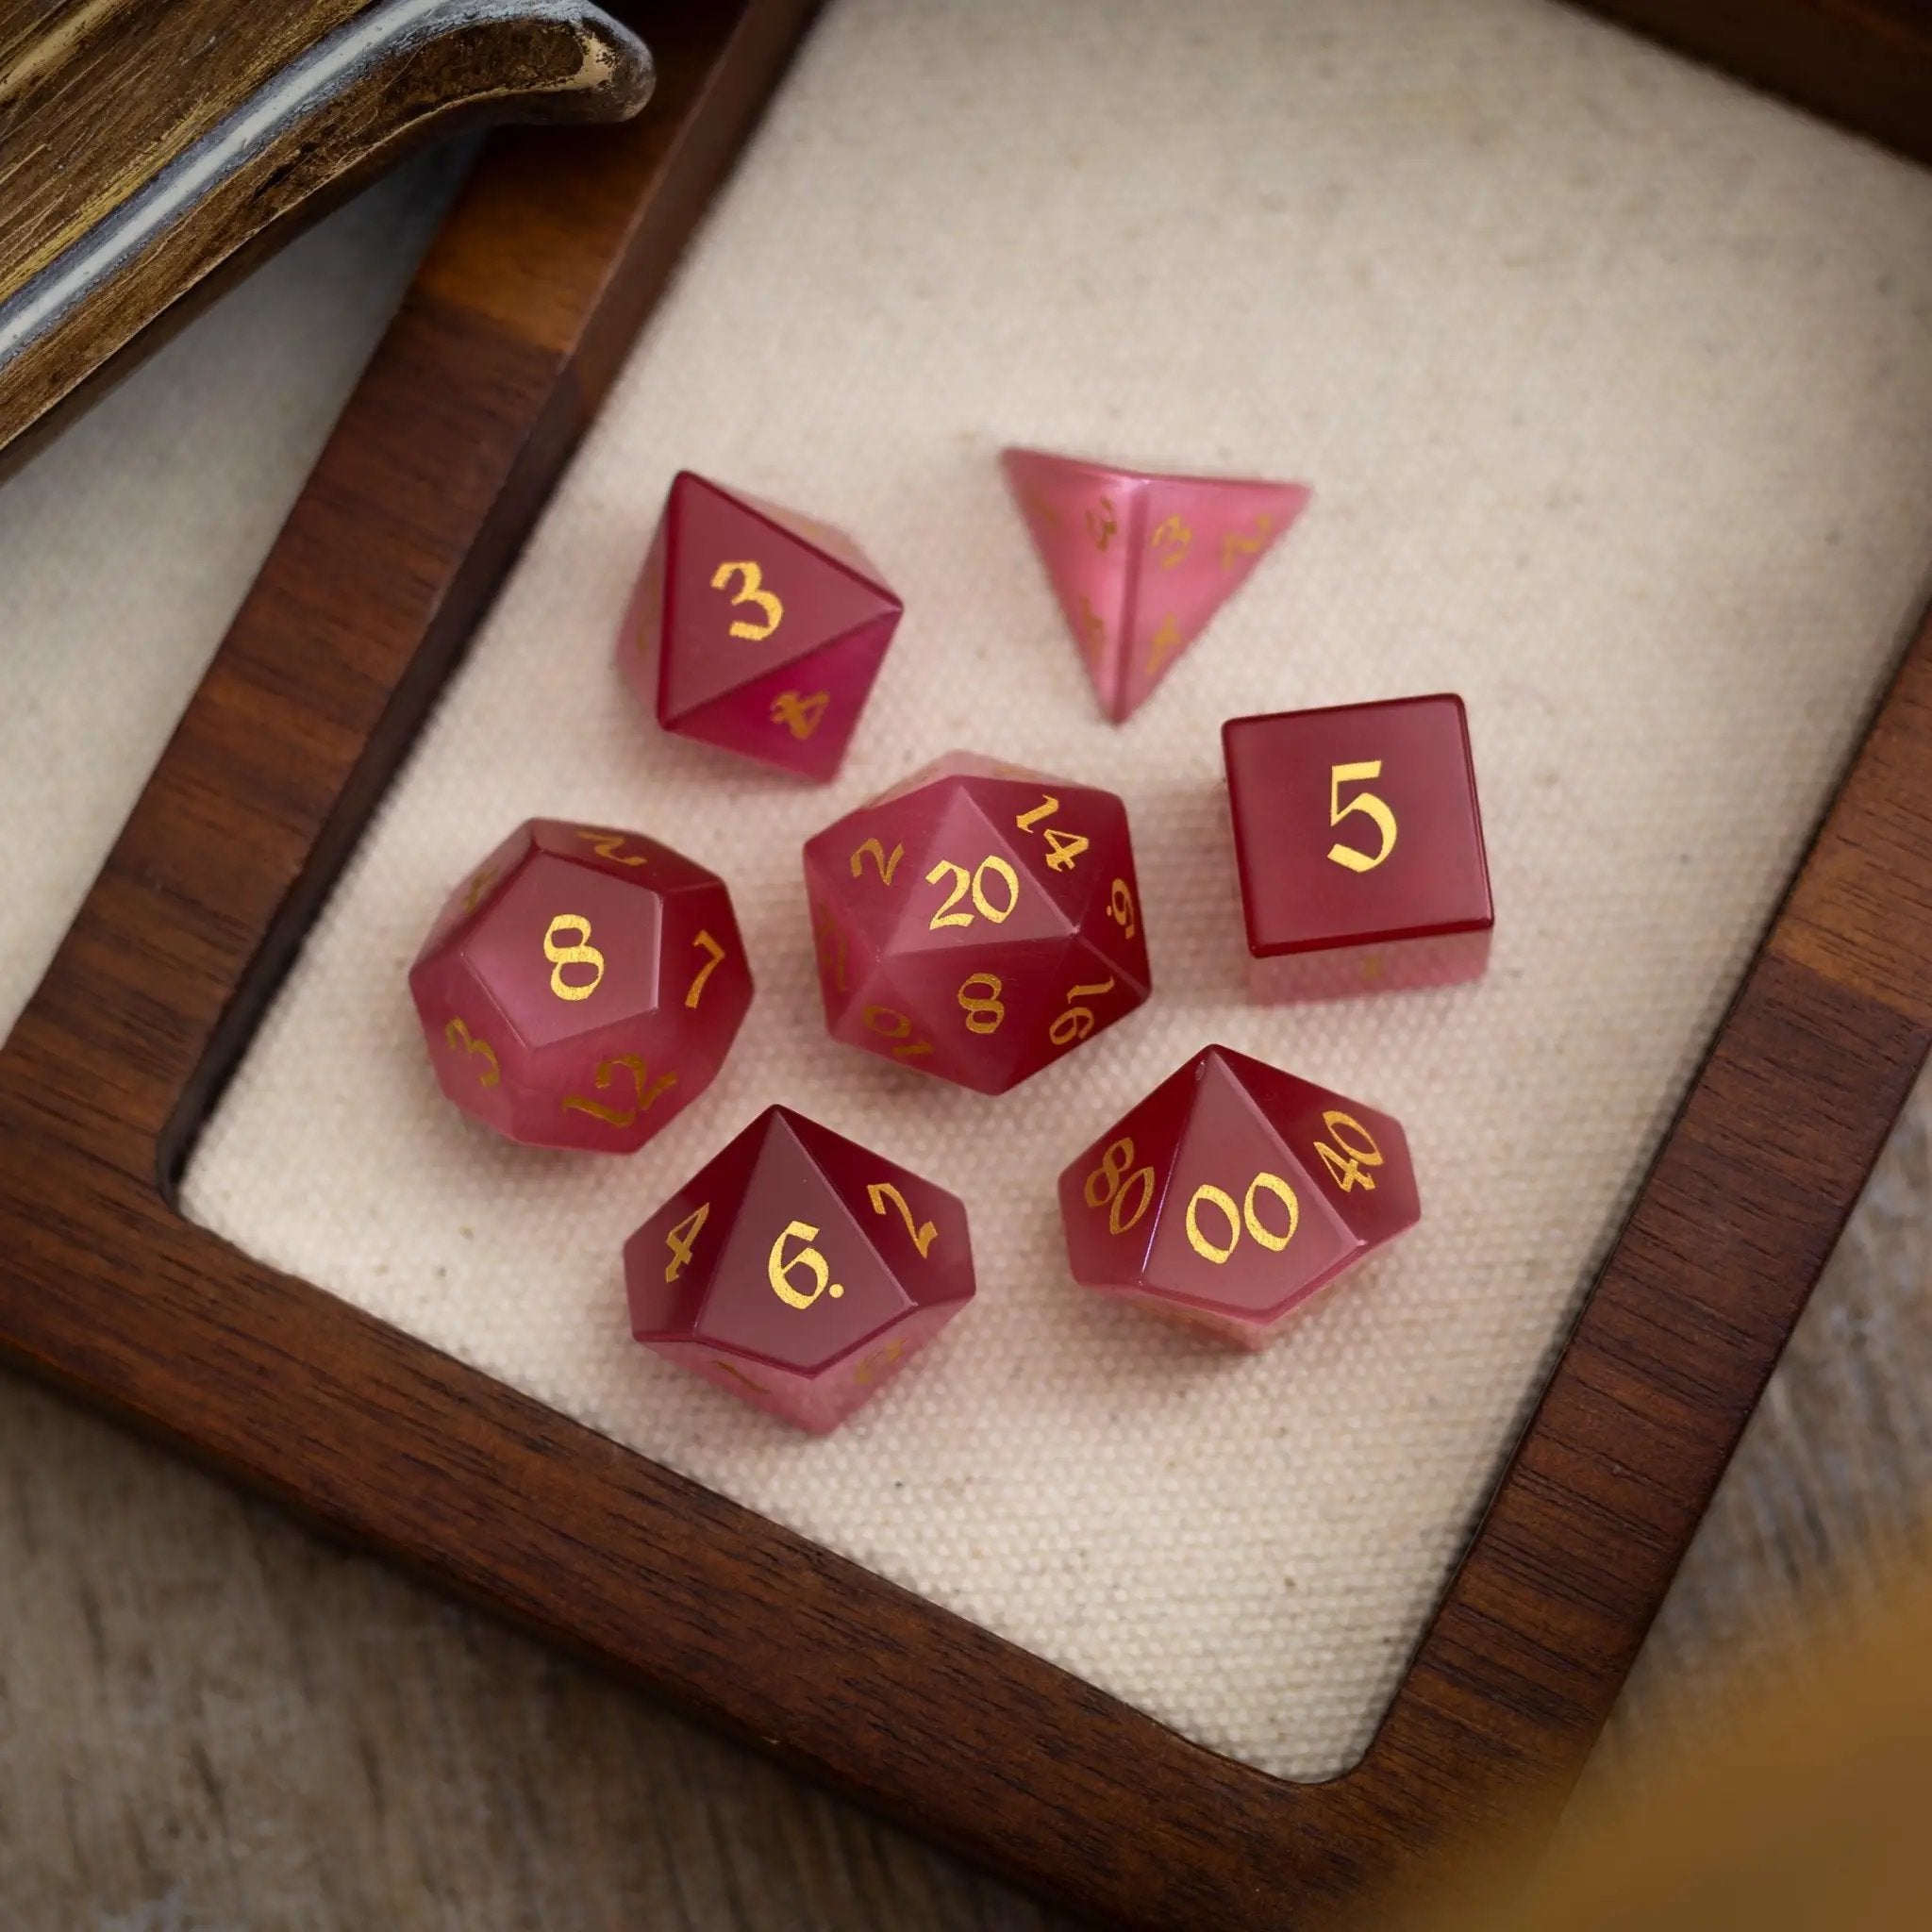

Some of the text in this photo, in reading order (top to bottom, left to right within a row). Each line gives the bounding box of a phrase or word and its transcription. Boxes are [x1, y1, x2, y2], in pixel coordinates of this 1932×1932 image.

[710, 561, 784, 641] 3
[1016, 794, 1090, 873] 14
[1327, 759, 1397, 873] 5
[850, 837, 905, 886] 2
[924, 855, 1020, 931] 20
[542, 913, 606, 1001] 8
[685, 929, 725, 1009] 7
[957, 973, 1006, 1035] 8
[1049, 975, 1116, 1045] 16
[561, 1054, 678, 1127] 12
[1084, 1137, 1156, 1236] 80
[1312, 1110, 1384, 1193] 40
[665, 1202, 710, 1284] 4
[867, 1182, 939, 1260] 2
[1185, 1172, 1300, 1265] 00
[768, 1220, 845, 1310] 6.
